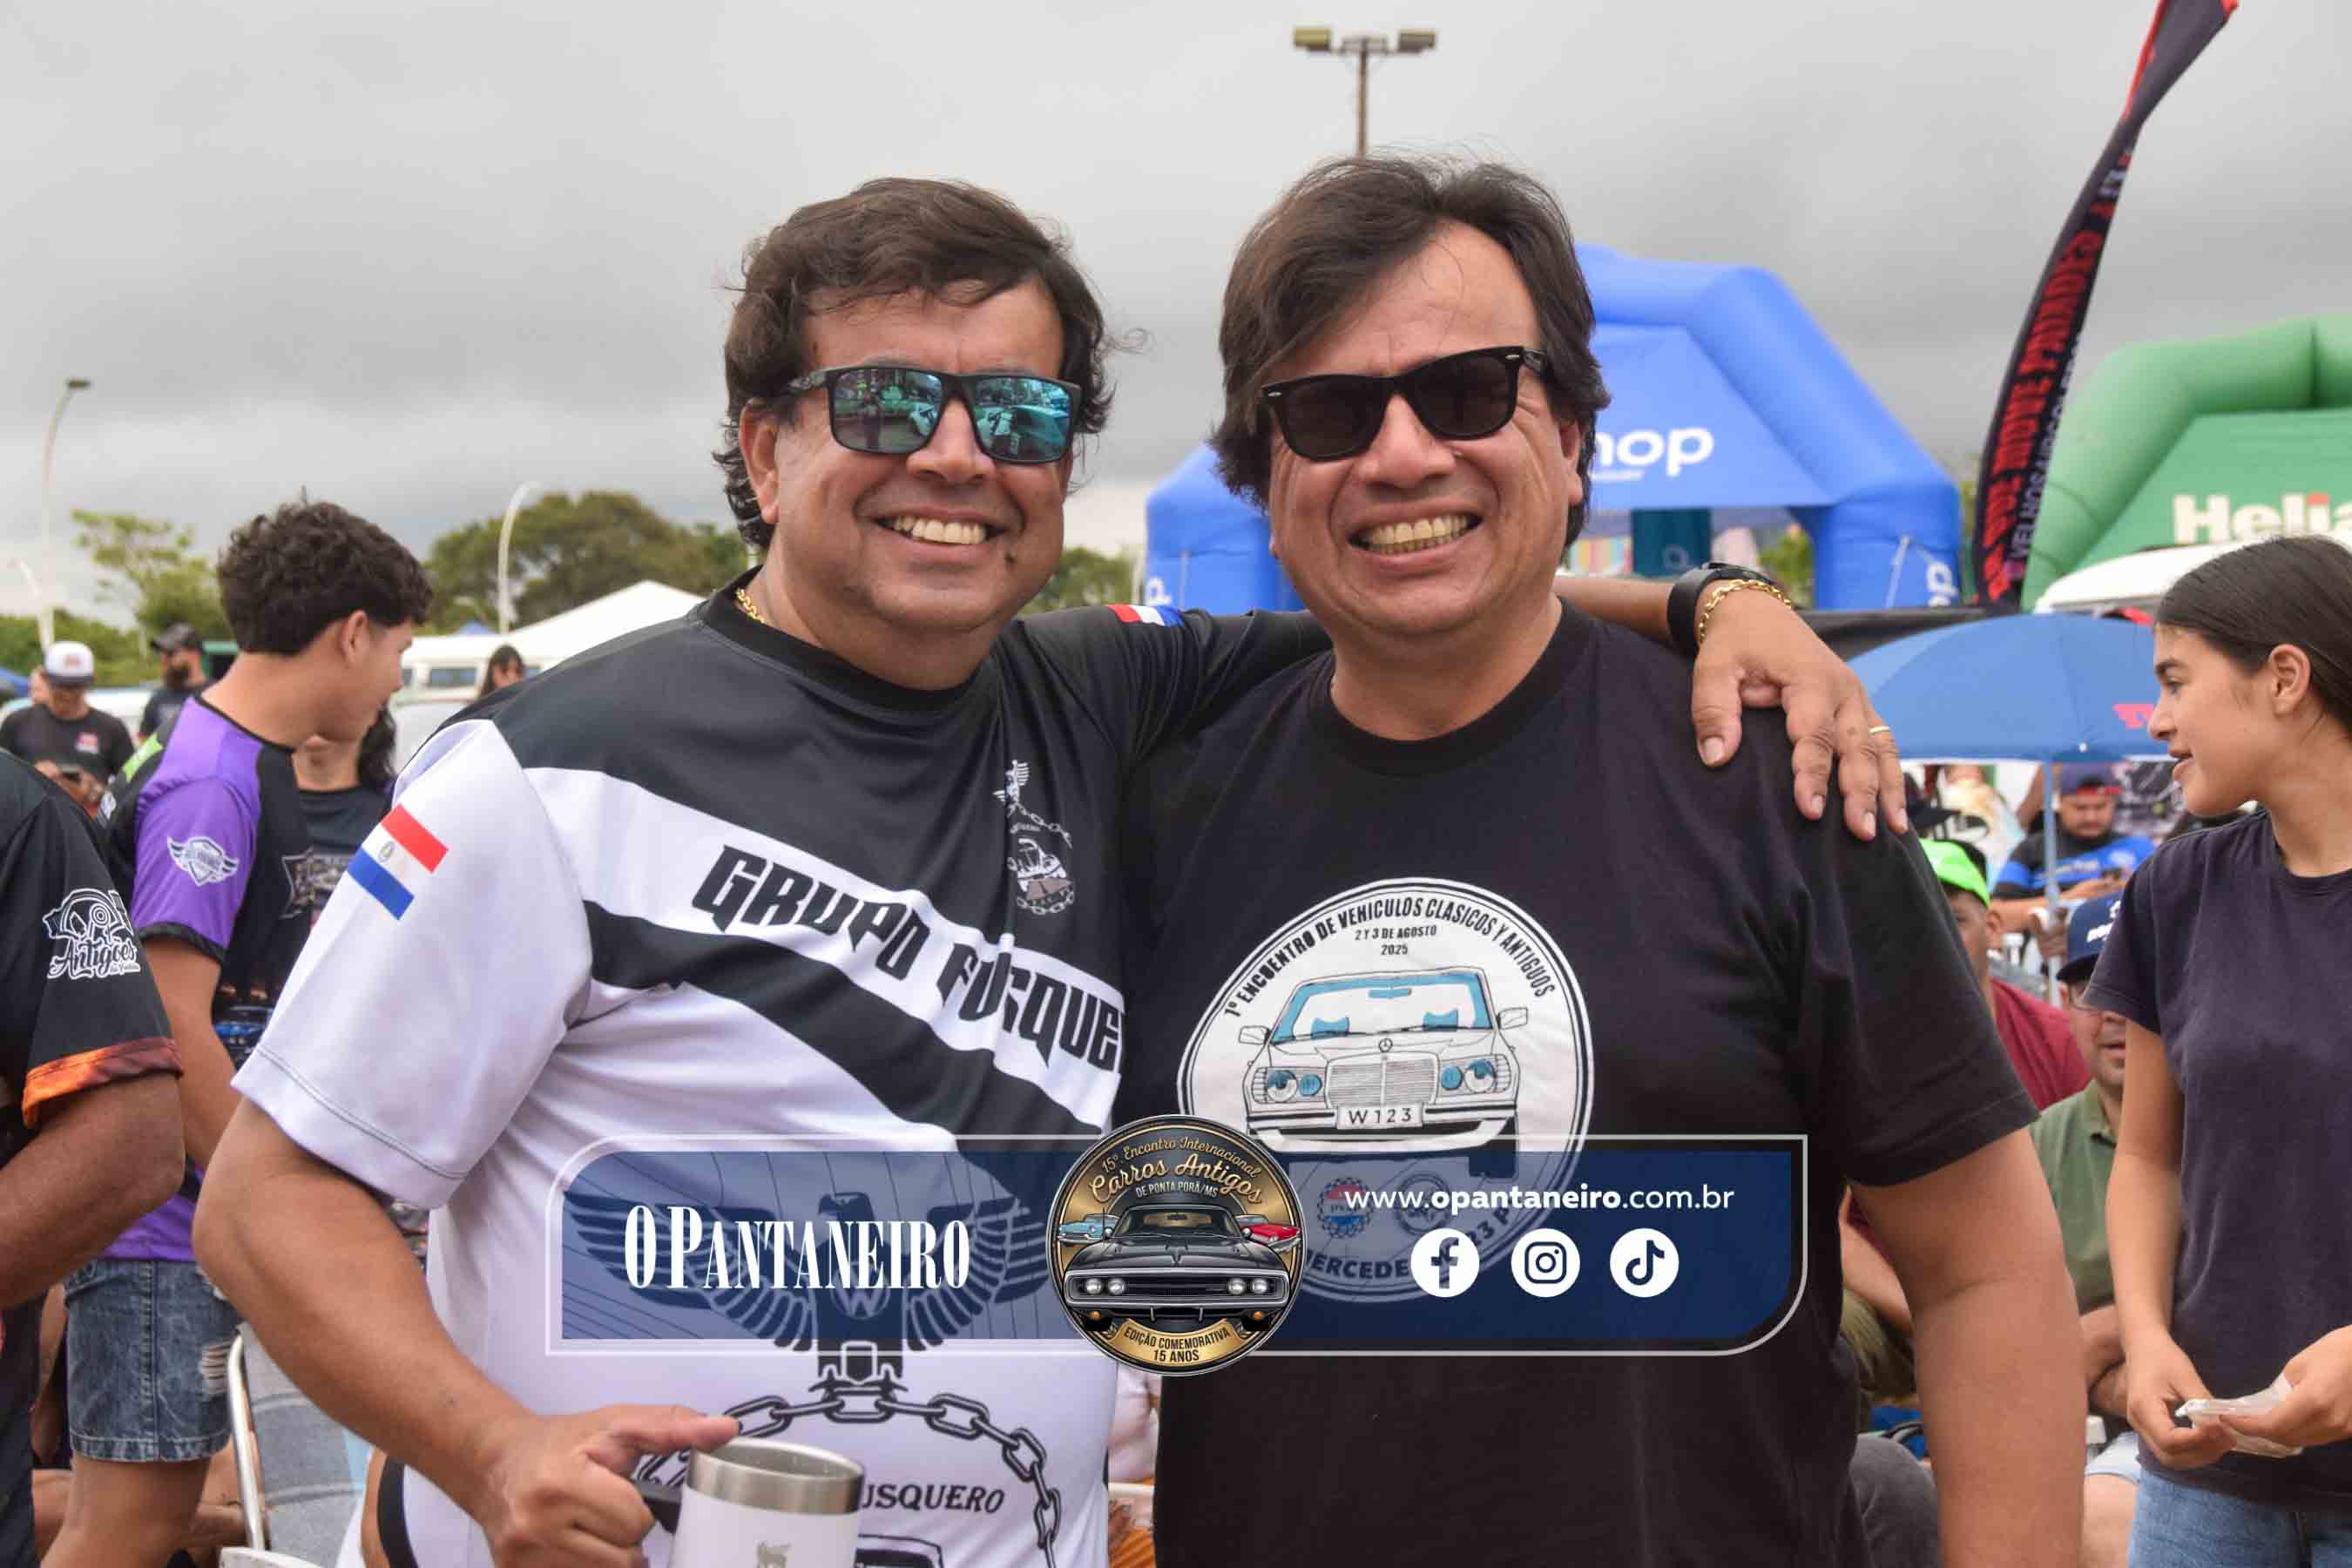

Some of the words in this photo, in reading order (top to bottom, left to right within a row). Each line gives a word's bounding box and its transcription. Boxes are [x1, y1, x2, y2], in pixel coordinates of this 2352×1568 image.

[692, 844, 929, 982] GRUPO
[1338, 896, 1423, 929] VEHICULOS
[1426, 898, 1497, 936] CLASICOS
[1315, 917, 1337, 941] DE
[1396, 924, 1437, 939] AGOSTO
[1492, 923, 1510, 942] Y
[1381, 943, 1409, 956] 2025
[1499, 932, 1556, 997] ANTIGUOS
[1306, 1247, 1411, 1281] ERCEDE
[862, 1483, 1005, 1514] USQUERO
